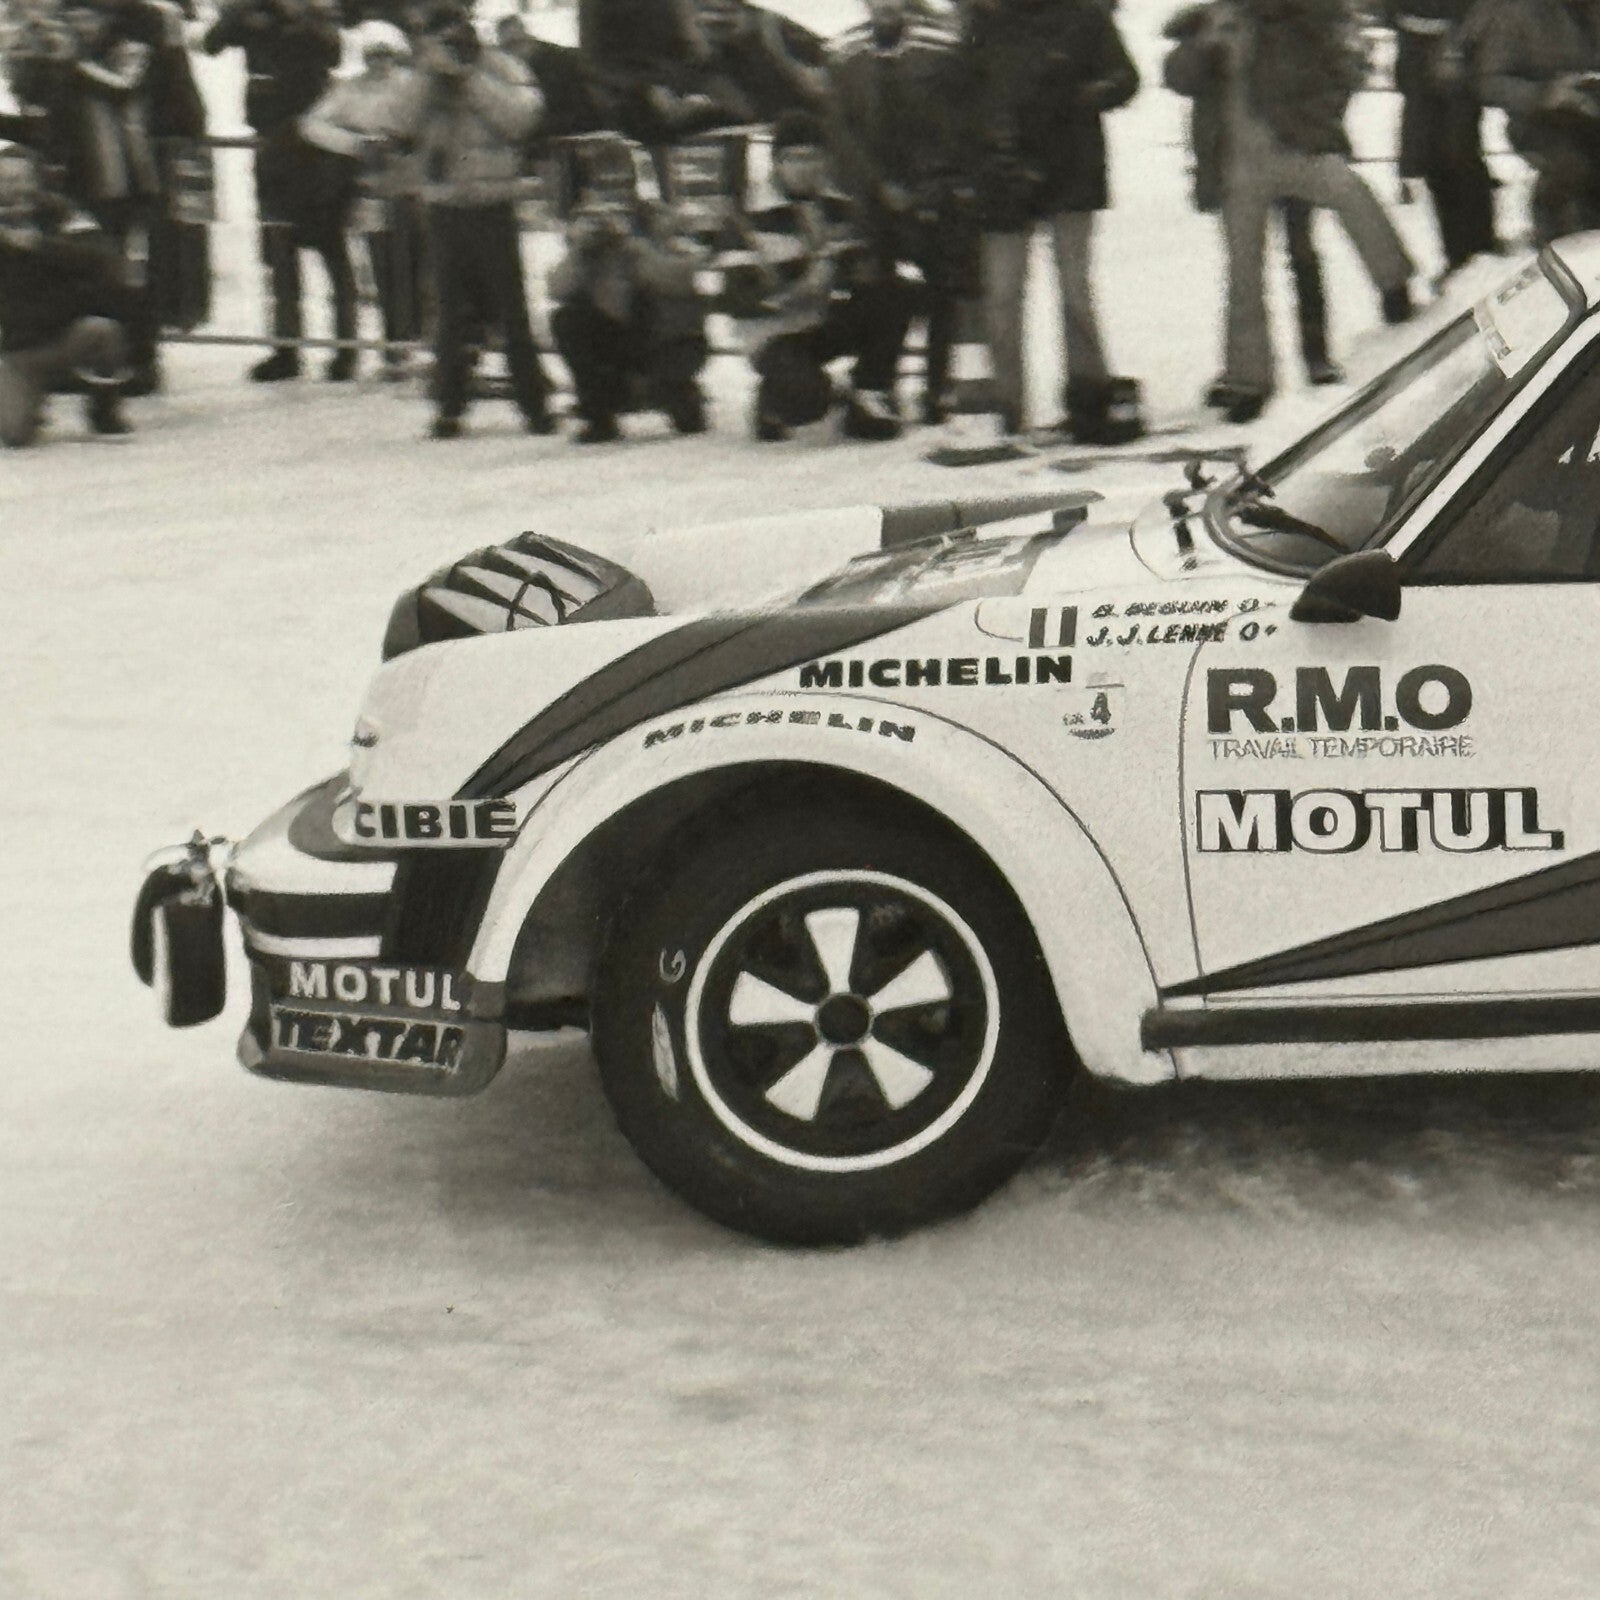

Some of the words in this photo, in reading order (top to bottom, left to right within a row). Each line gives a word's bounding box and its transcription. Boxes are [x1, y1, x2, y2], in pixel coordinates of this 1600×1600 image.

[800, 655, 1073, 688] MICHELIN
[1207, 664, 1473, 732] R.M.O
[643, 710, 916, 748] MICHELIN
[355, 801, 520, 838] CIBIE
[1196, 787, 1565, 853] MOTUL
[289, 962, 461, 1011] MOTUL
